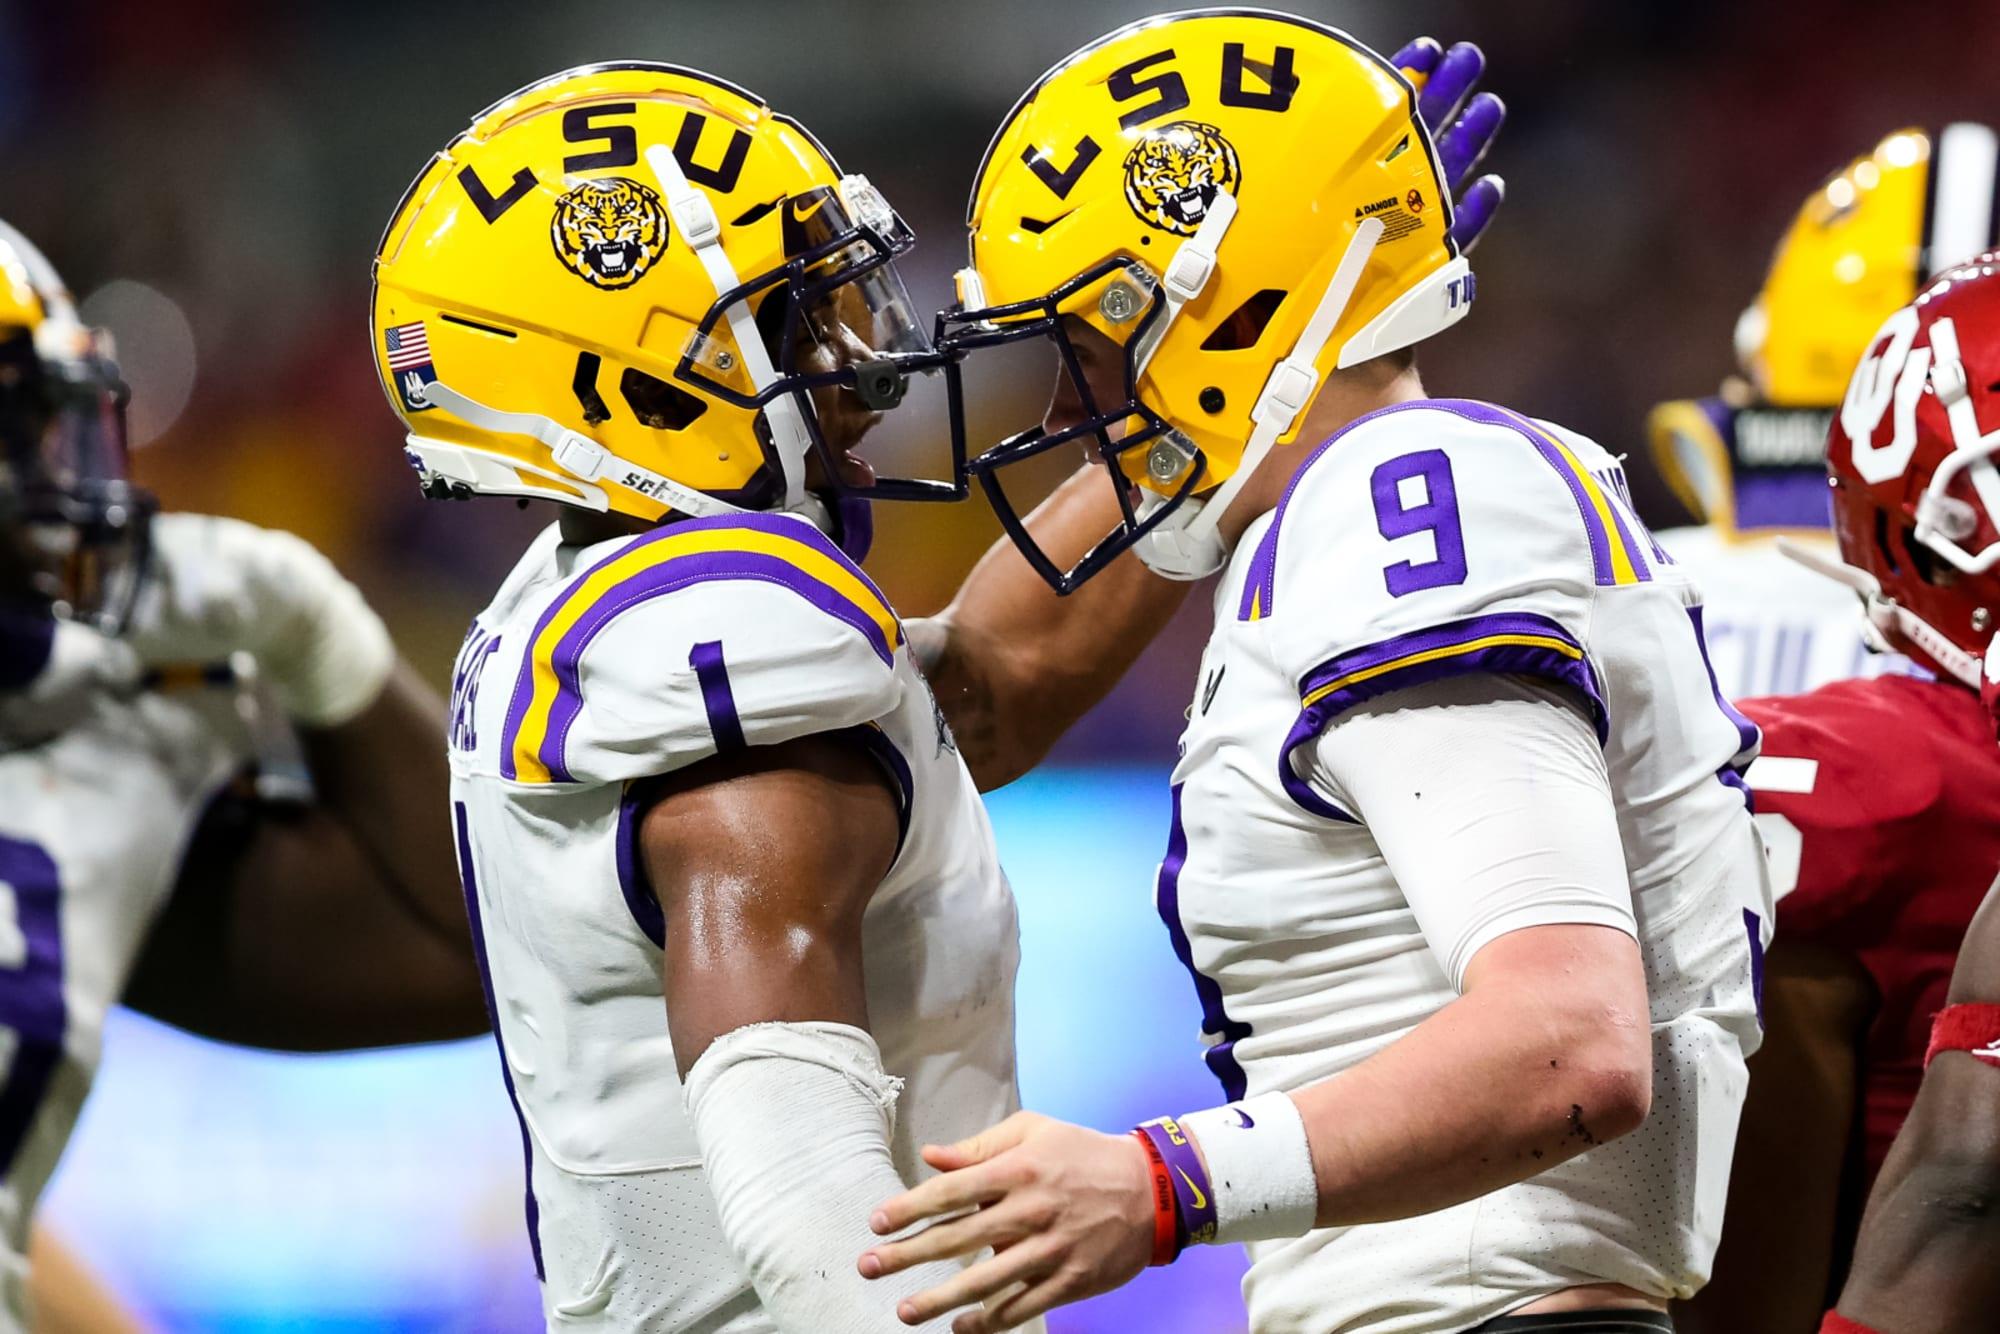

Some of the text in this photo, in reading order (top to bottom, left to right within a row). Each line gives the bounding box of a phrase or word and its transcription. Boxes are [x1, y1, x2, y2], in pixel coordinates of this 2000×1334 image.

[456, 103, 752, 224] LSU
[1021, 42, 1297, 201] LSU
[1363, 197, 1399, 215] DANGER
[1840, 306, 1931, 484] OU
[1370, 448, 1468, 598] 9
[688, 640, 747, 754] 1
[1156, 1174, 1171, 1212] MIND
